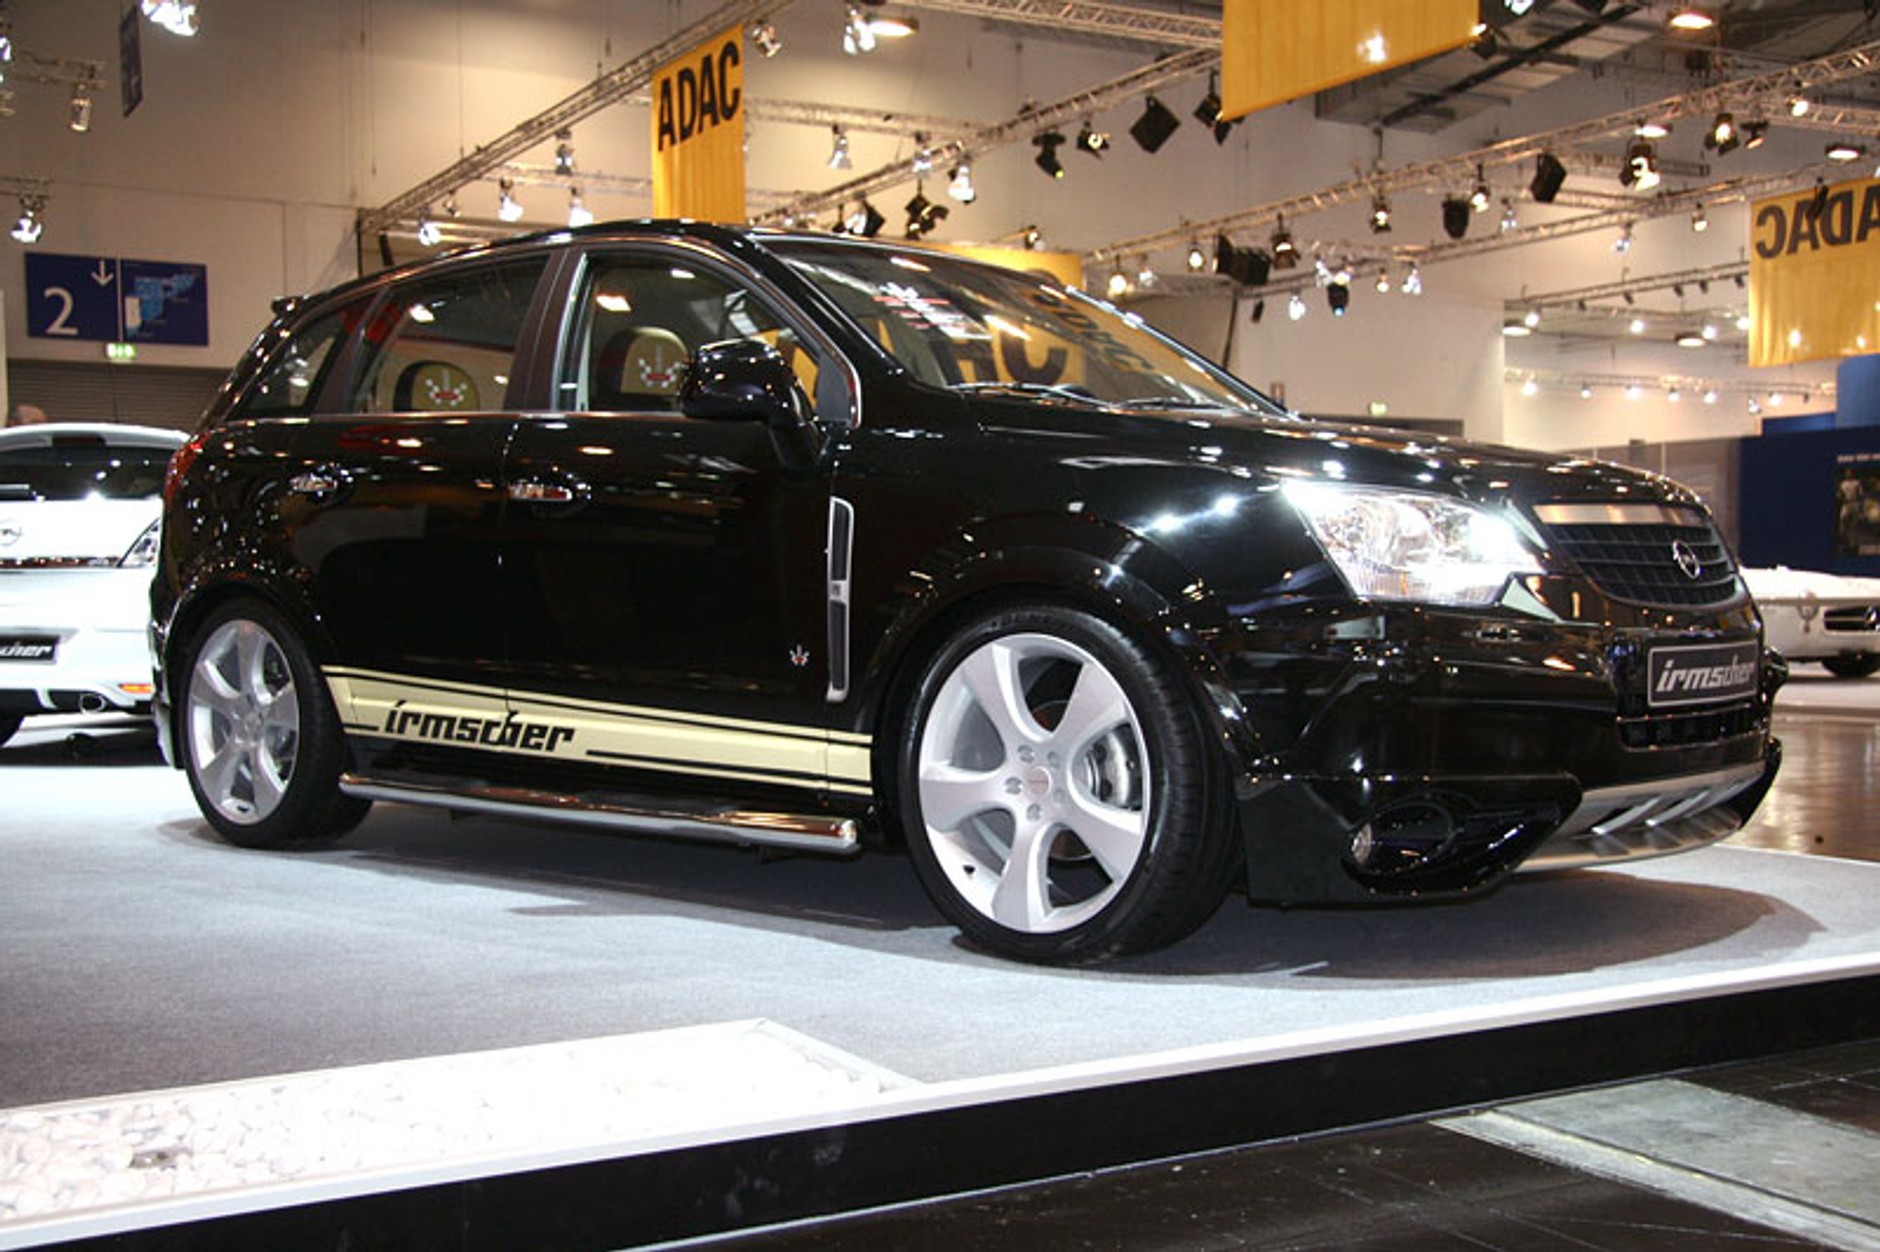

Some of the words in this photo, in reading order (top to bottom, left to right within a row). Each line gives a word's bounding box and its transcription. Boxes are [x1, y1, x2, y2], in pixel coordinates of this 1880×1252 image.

[658, 40, 740, 152] ADAC
[44, 286, 79, 336] 2
[1655, 653, 1756, 692] irmscher
[385, 699, 576, 752] irmscher
